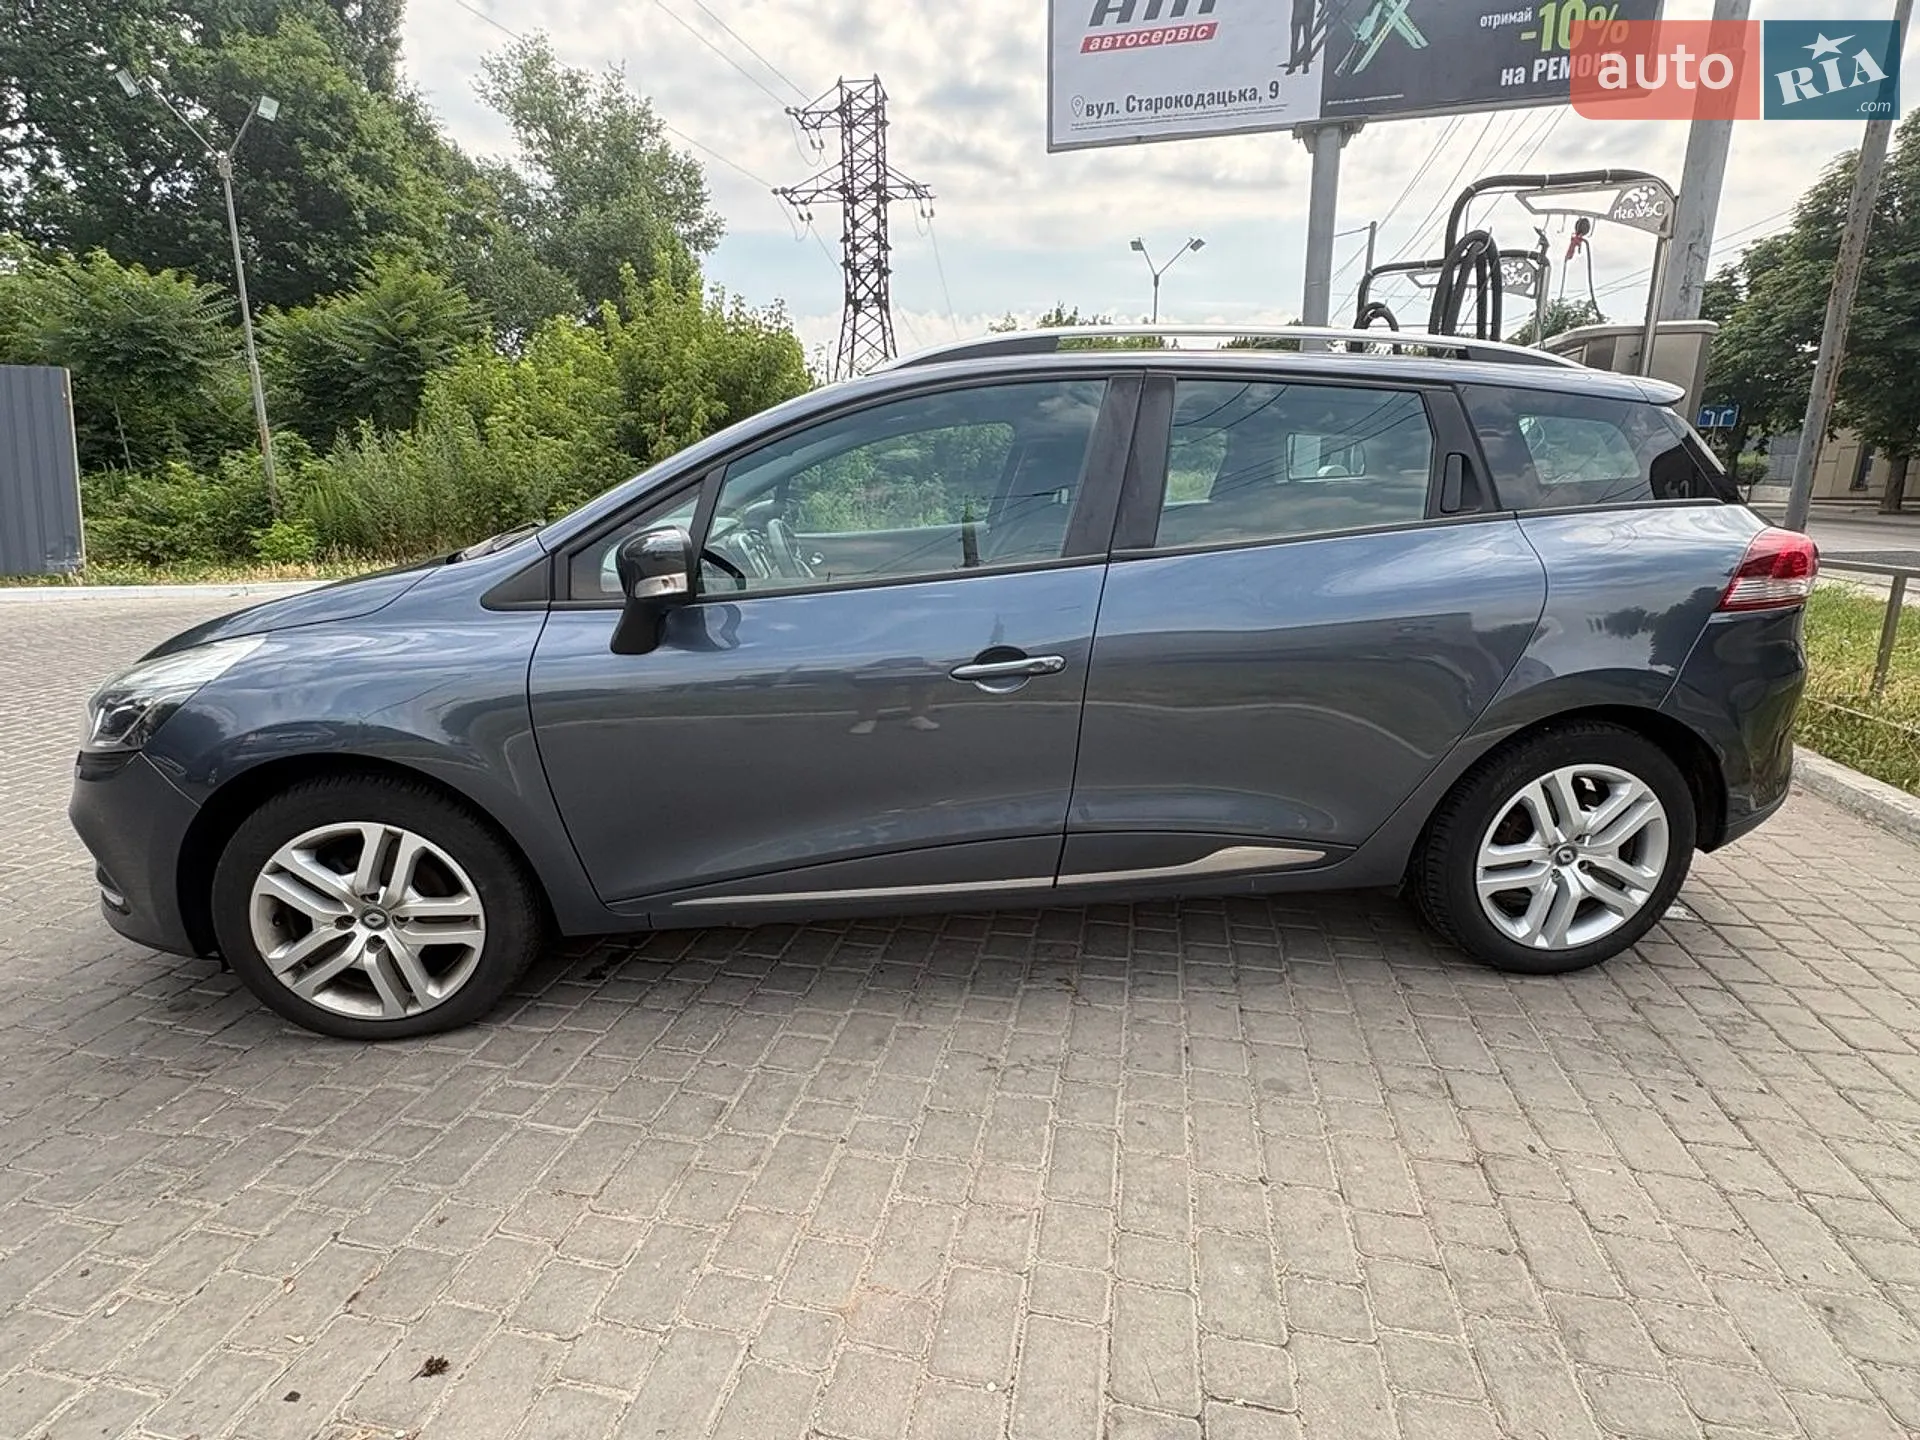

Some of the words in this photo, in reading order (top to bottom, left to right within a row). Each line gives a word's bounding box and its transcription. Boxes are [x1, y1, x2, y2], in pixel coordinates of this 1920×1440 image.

[1480, 7, 1533, 29] отримай
[1520, 0, 1630, 52] -10%
[1089, 25, 1209, 50] автосервіс
[1500, 65, 1526, 86] на
[1085, 100, 1120, 119] вул.
[1126, 86, 1263, 113] Старокодацька,
[1269, 80, 1280, 99] 9
